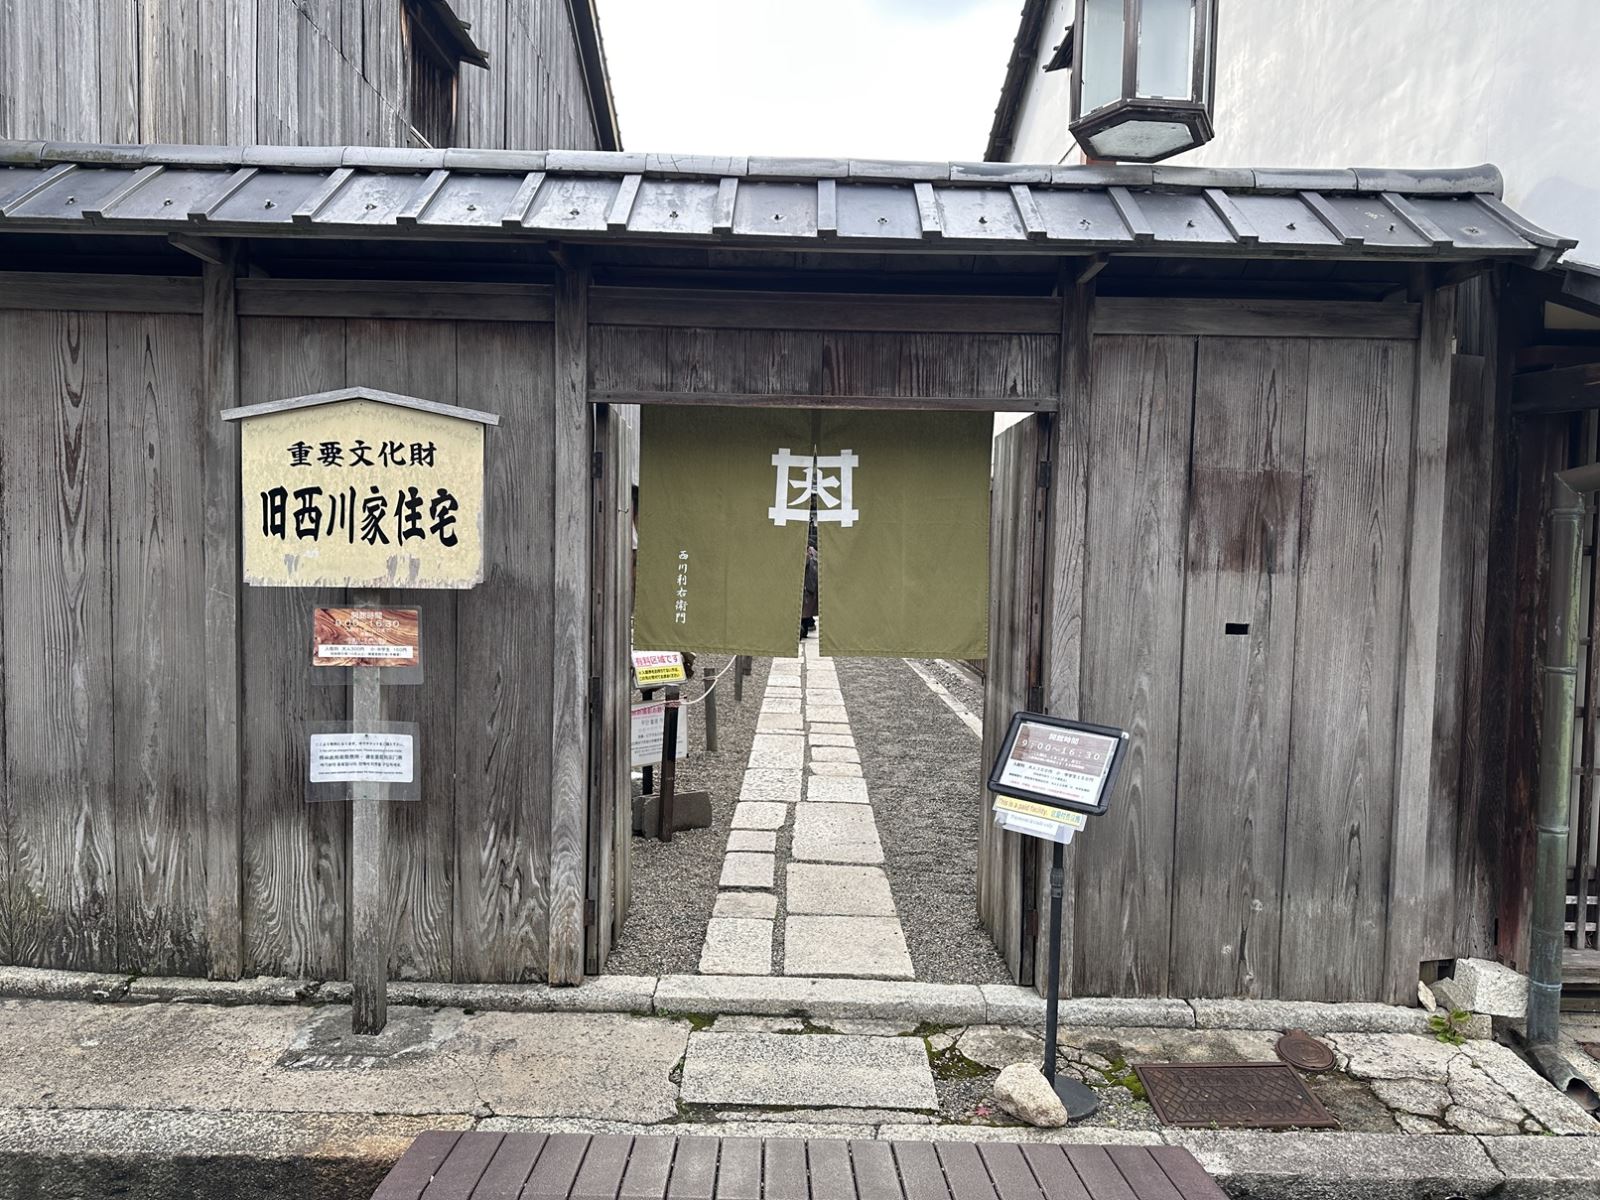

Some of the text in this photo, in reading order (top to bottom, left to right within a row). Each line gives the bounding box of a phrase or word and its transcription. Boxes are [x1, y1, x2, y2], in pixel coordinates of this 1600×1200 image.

[287, 440, 437, 468] 重要文化財
[260, 485, 459, 548] 旧西川家住宅
[675, 550, 689, 625] 西川利右衛門
